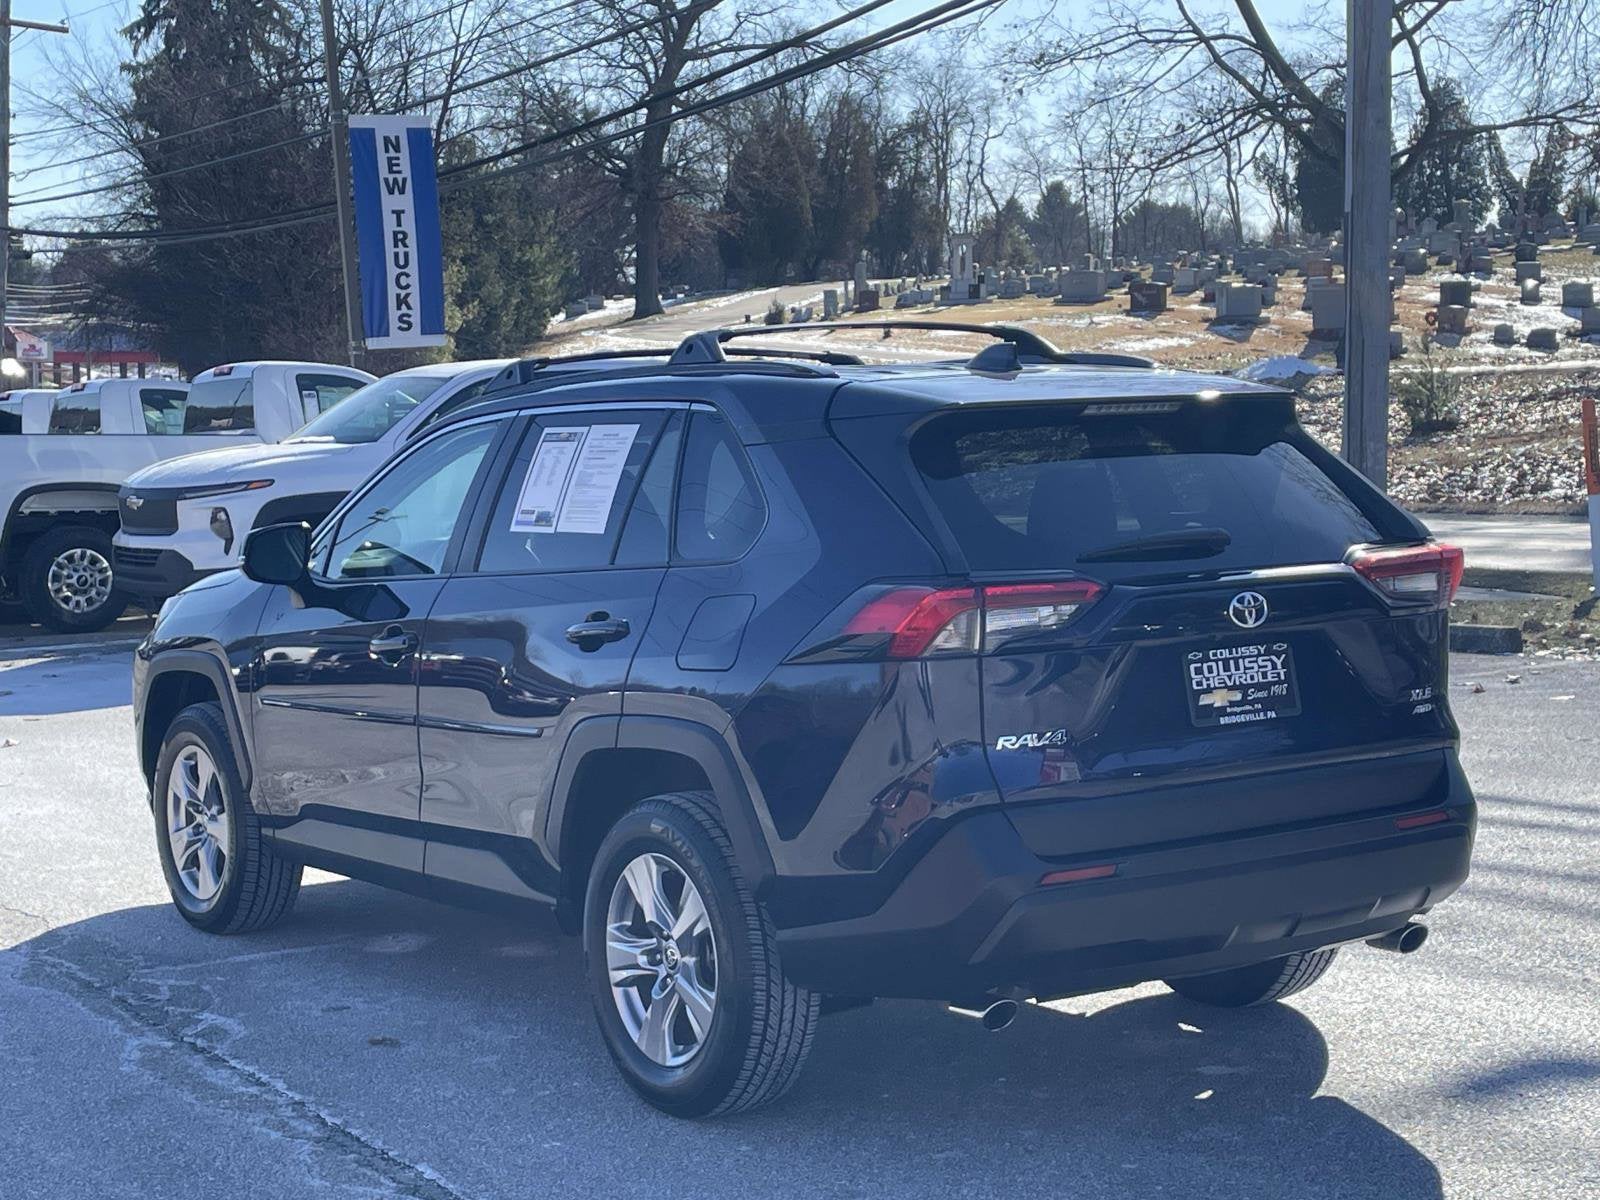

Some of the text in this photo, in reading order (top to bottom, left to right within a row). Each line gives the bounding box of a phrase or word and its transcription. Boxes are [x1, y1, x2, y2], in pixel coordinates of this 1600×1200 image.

[383, 135, 413, 332] NEW TRUCKS
[1209, 644, 1267, 660] COLUSSY
[1189, 654, 1286, 679] COLUSSY
[1192, 669, 1287, 690] CHEVROLET
[1247, 684, 1288, 700] Since 1918
[1267, 711, 1277, 719] PA
[996, 729, 1067, 750] RAV4
